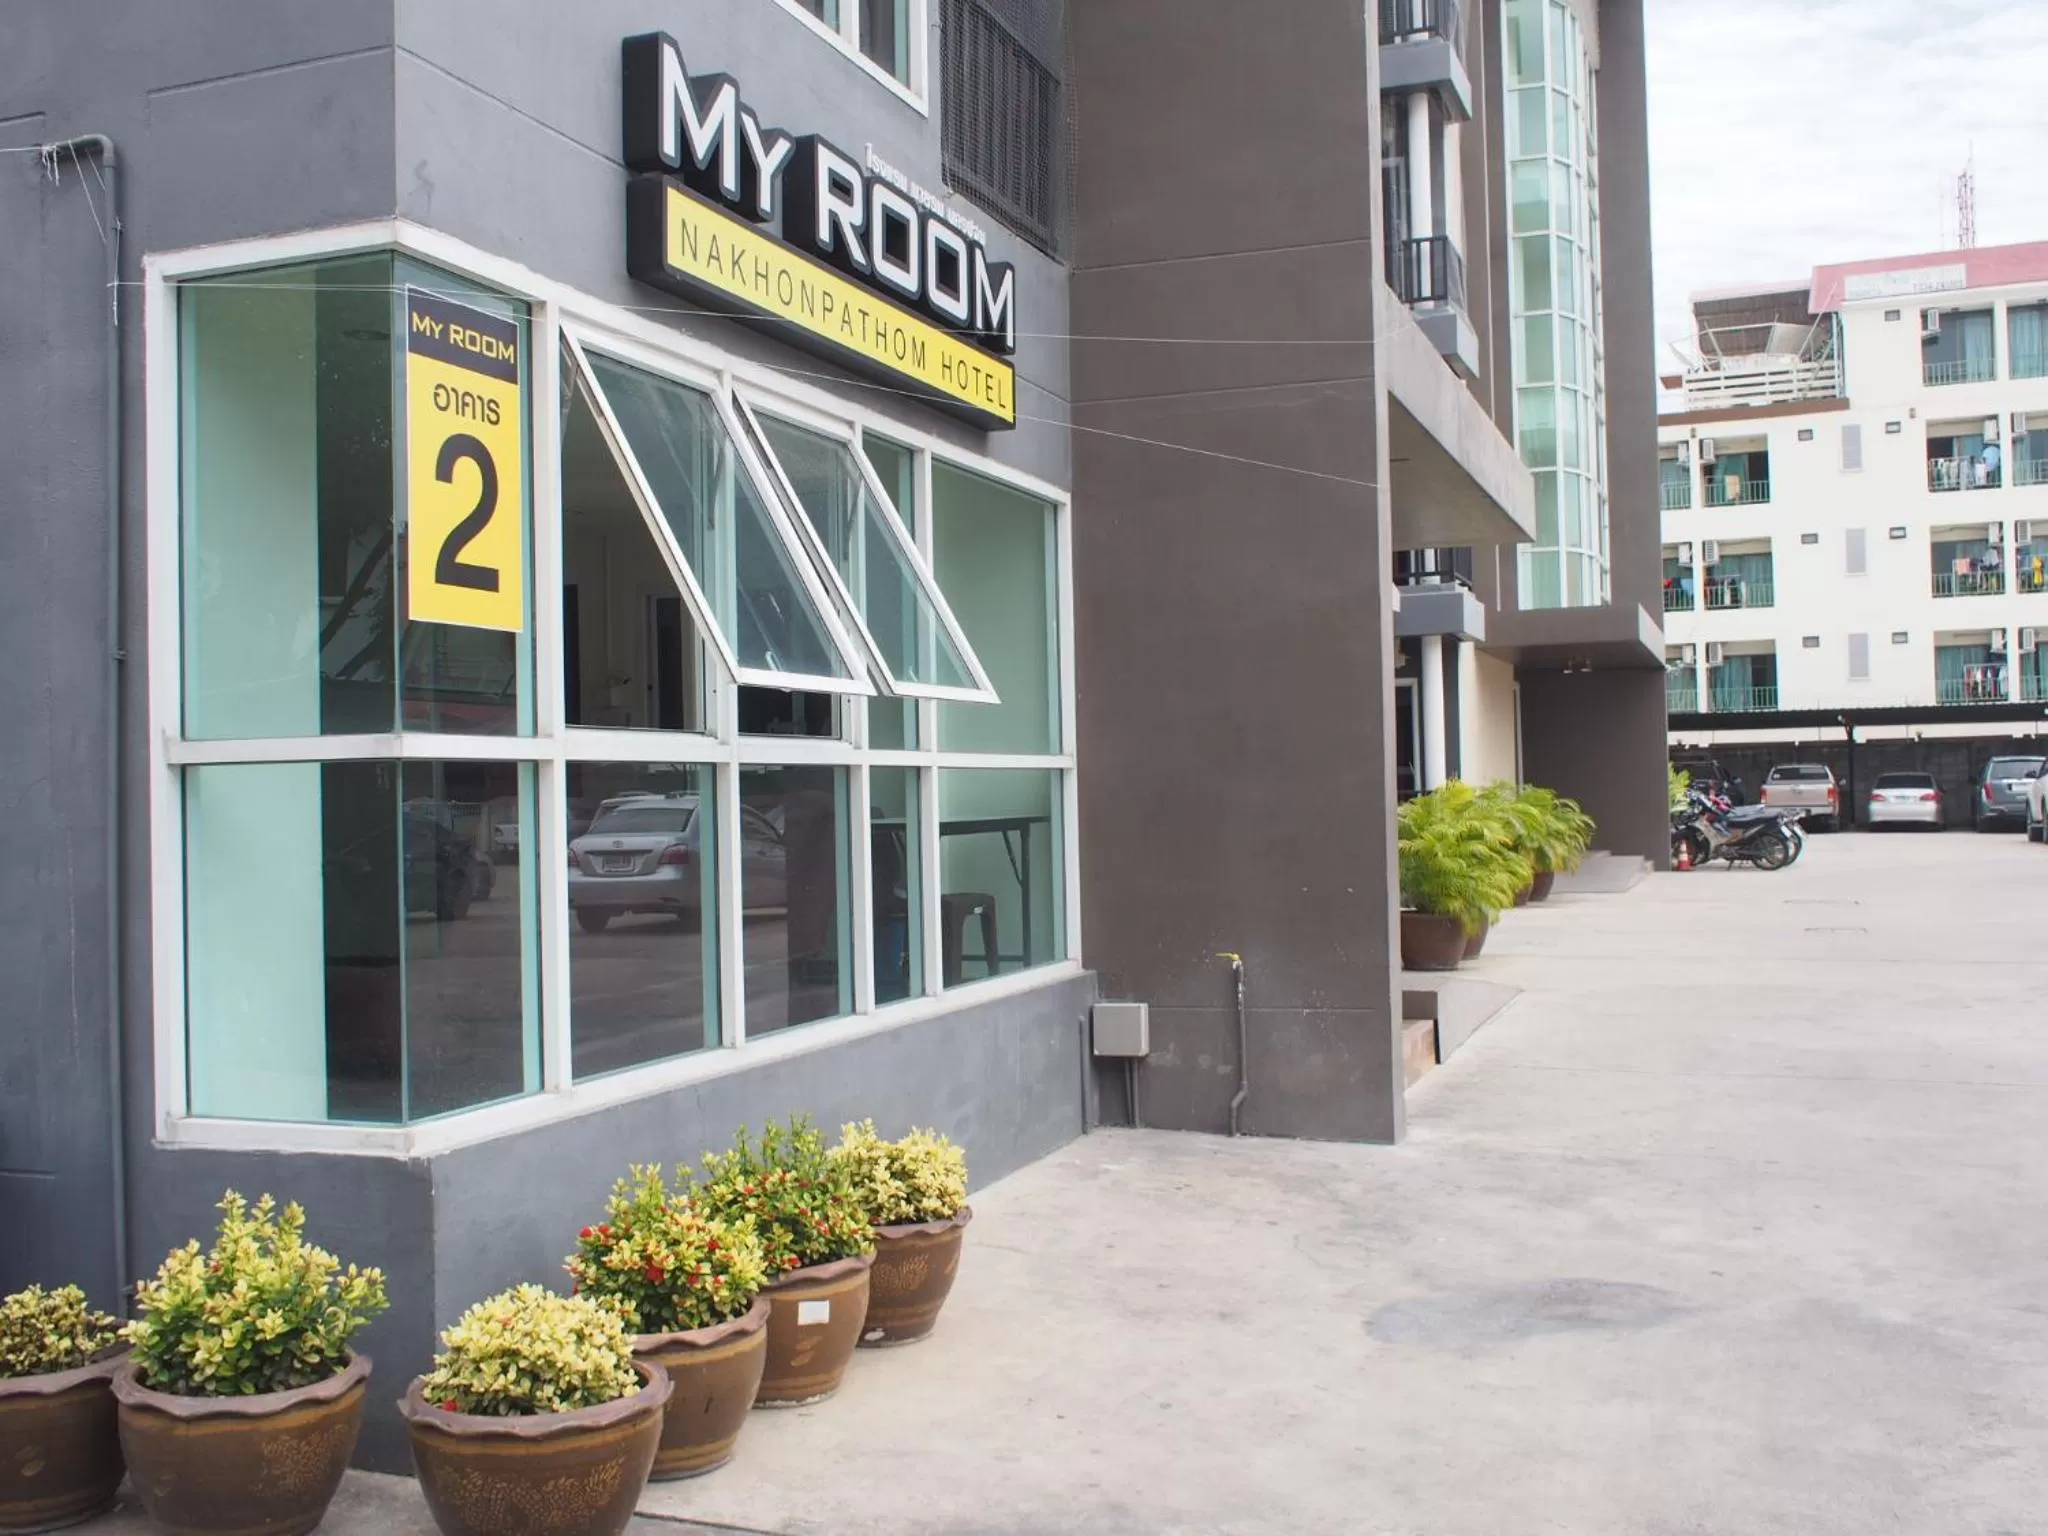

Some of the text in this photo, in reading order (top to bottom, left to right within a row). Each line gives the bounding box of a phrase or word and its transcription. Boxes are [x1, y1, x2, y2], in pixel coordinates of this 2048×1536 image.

[661, 42, 1014, 349] MY ROOM
[412, 310, 514, 364] MY ROOM
[681, 217, 1006, 409] NAKHONPATHOM HOTEL
[433, 383, 500, 426] อาคาร
[435, 433, 499, 593] 2
